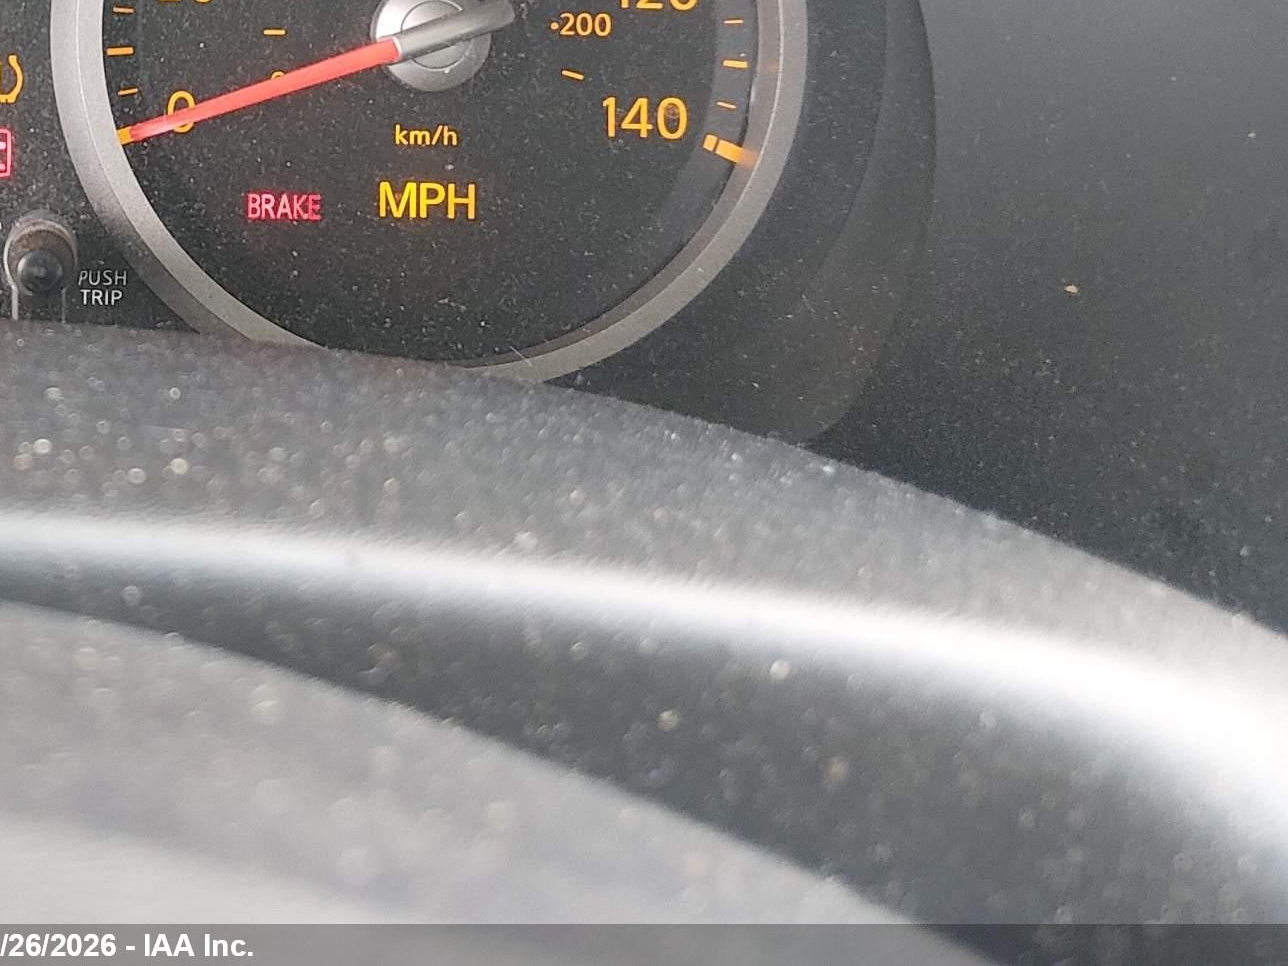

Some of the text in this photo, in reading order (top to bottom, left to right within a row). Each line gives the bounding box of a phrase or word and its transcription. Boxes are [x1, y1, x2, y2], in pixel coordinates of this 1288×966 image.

[560, 12, 611, 37] 200
[167, 90, 197, 134] 0
[602, 96, 687, 140] 140
[394, 124, 458, 148] km/h
[246, 193, 322, 222] BRAKE
[378, 181, 477, 221] MPH
[77, 269, 128, 286] PUSH
[79, 289, 124, 306] TRIP
